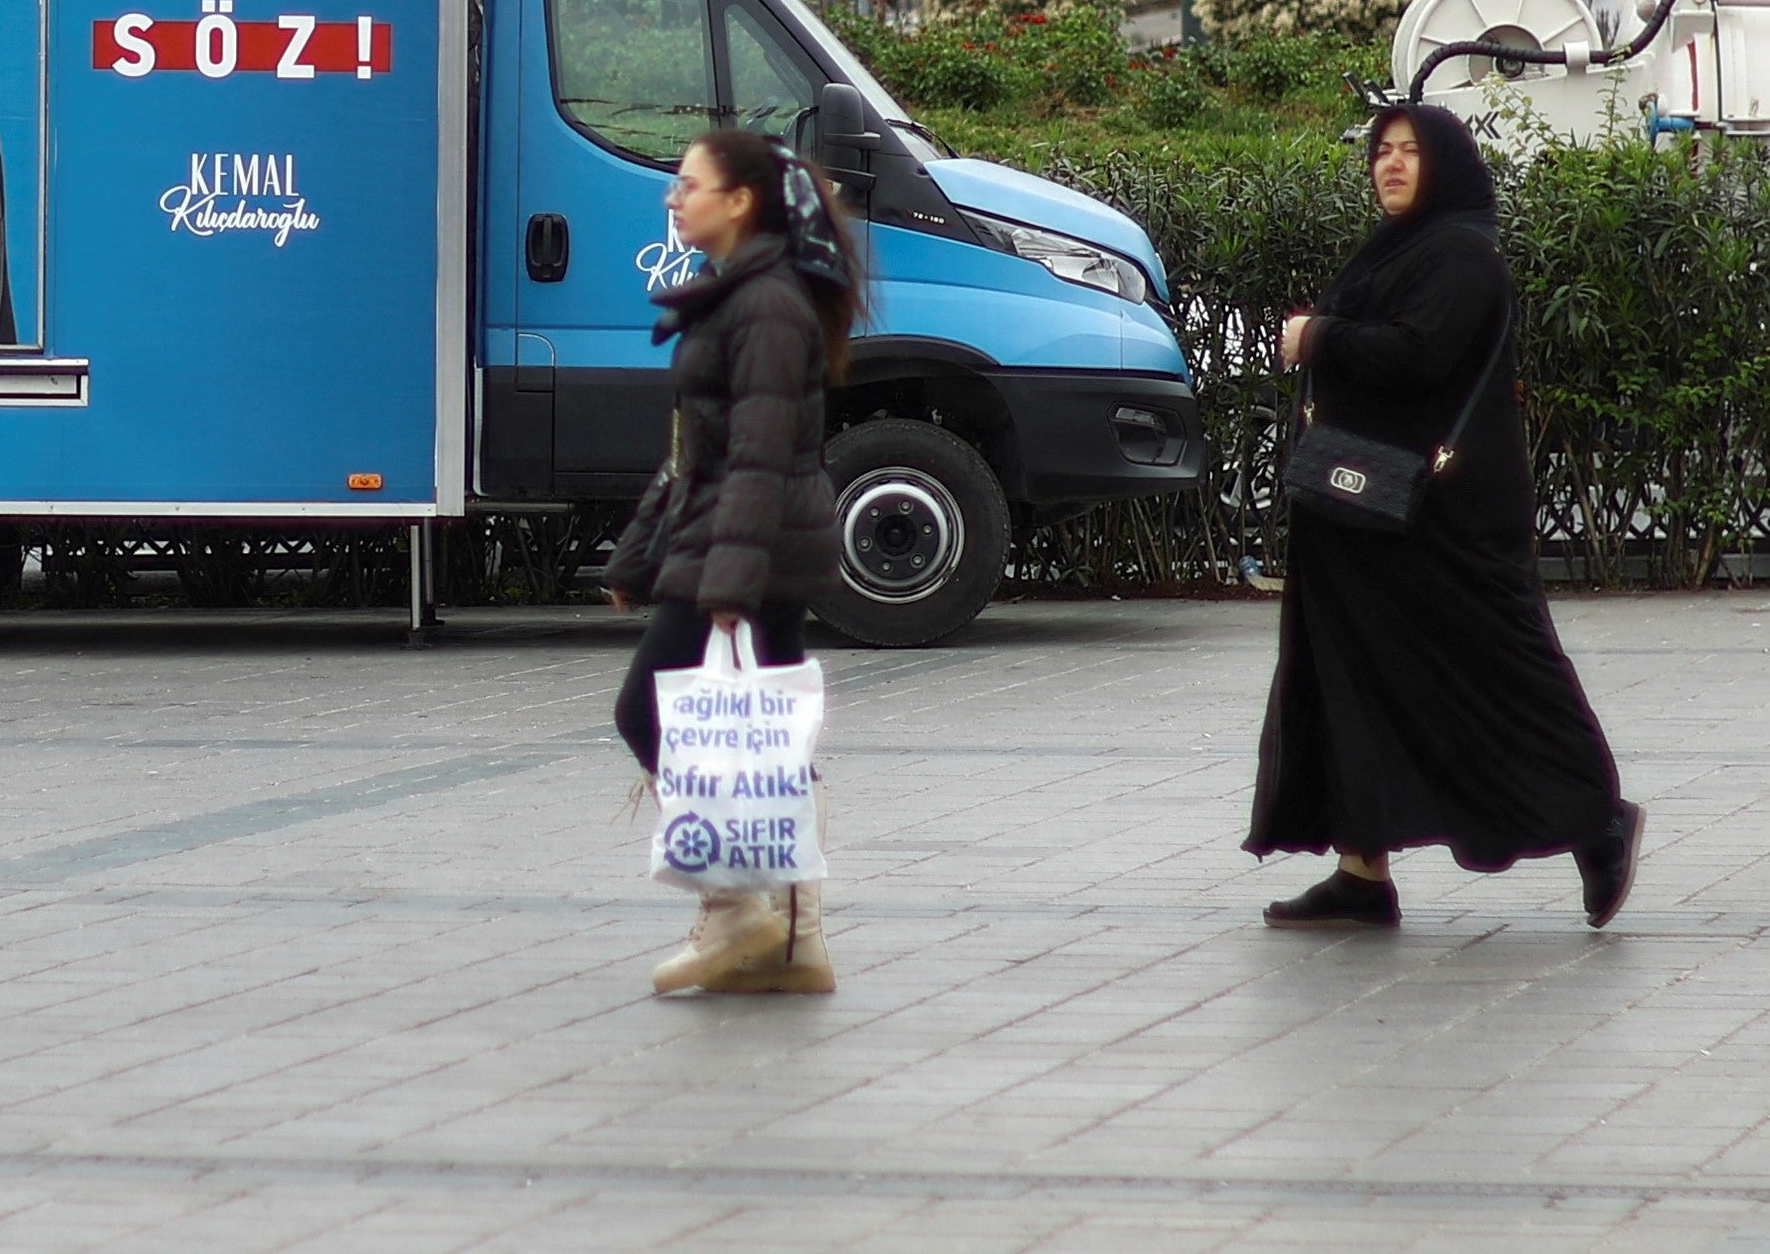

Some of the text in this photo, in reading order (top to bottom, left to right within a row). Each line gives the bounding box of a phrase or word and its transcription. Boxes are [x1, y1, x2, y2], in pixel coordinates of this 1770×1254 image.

[112, 0, 372, 80] SÖZ!
[191, 153, 299, 196] KEMAL
[759, 689, 797, 716] bir
[665, 721, 791, 755] çevre için
[725, 817, 797, 844] SIFIR
[727, 844, 798, 870] ATIK
